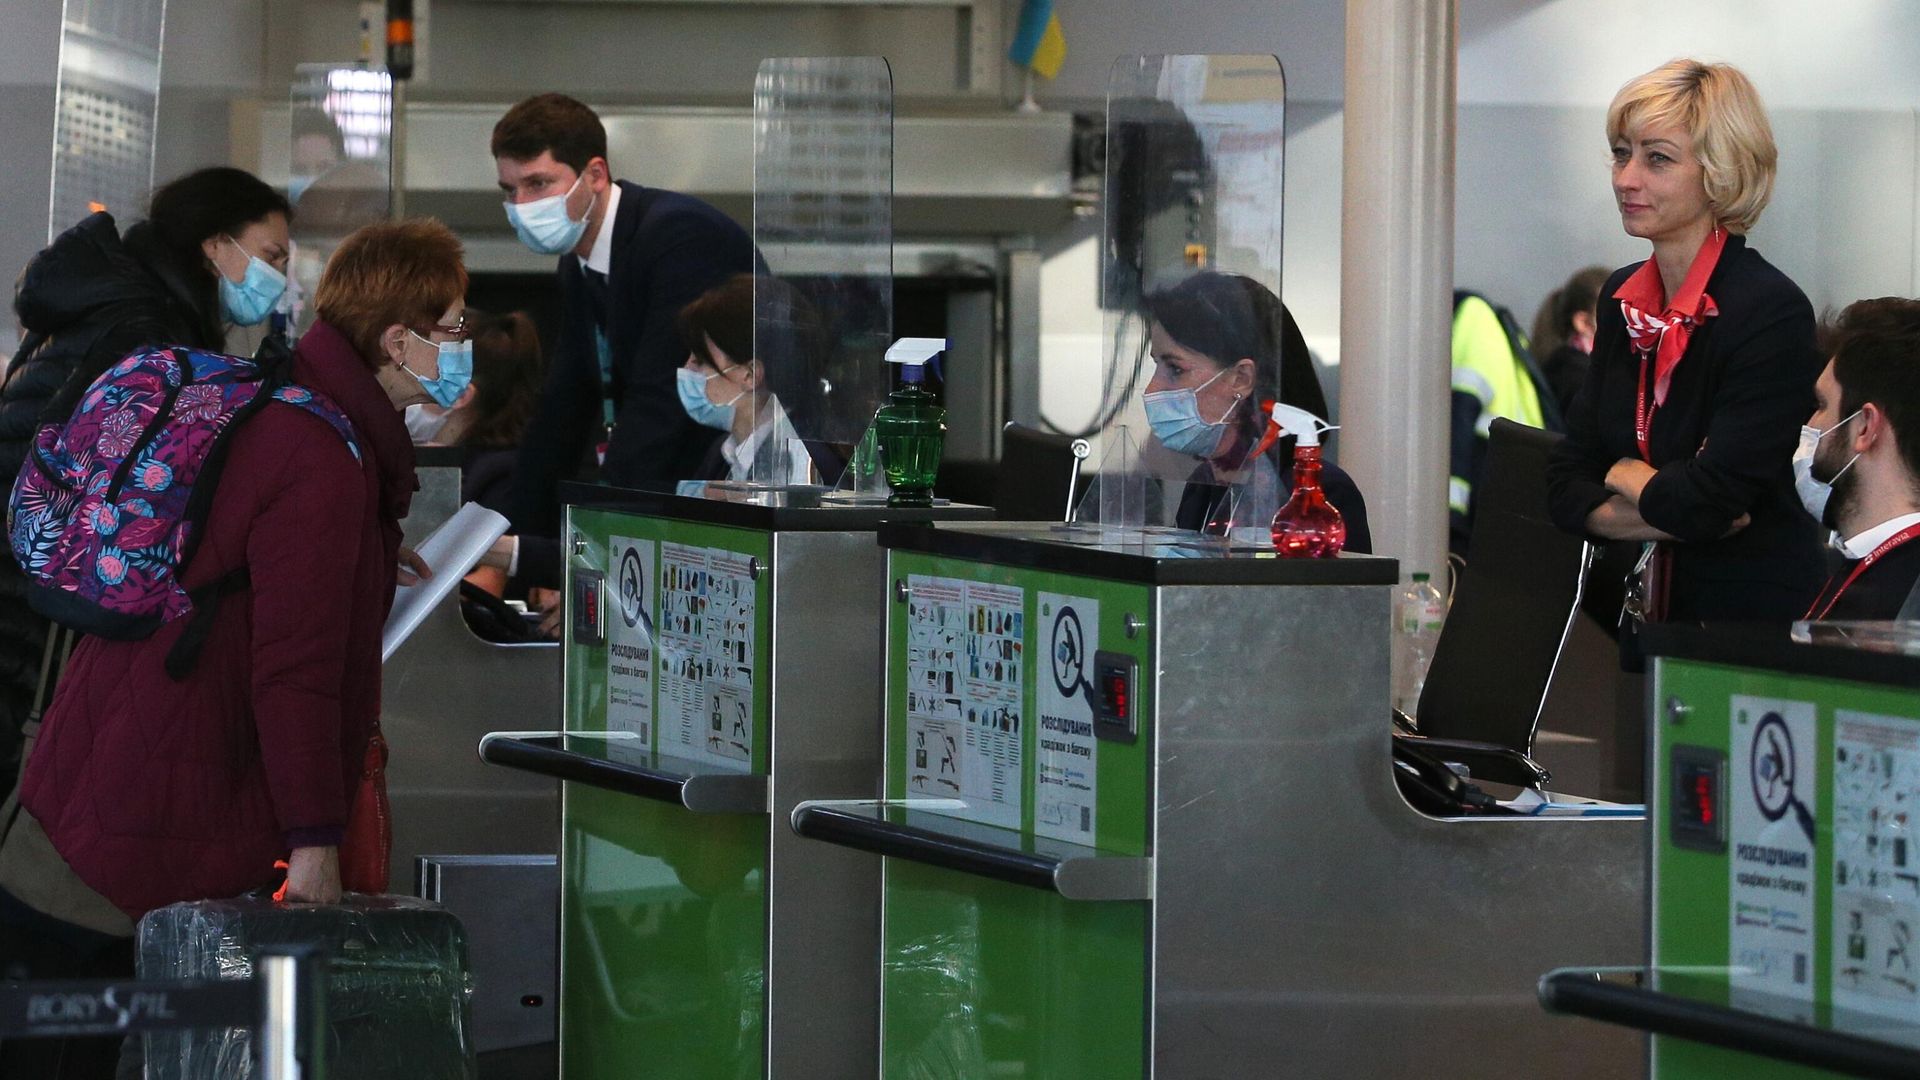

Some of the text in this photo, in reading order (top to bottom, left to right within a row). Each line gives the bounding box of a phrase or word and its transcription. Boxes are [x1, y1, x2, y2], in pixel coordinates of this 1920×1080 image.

[1636, 392, 1645, 430] Interavia
[1873, 531, 1910, 558] Interavia
[1041, 714, 1092, 737] РОЗСЛІДУВАННЯ
